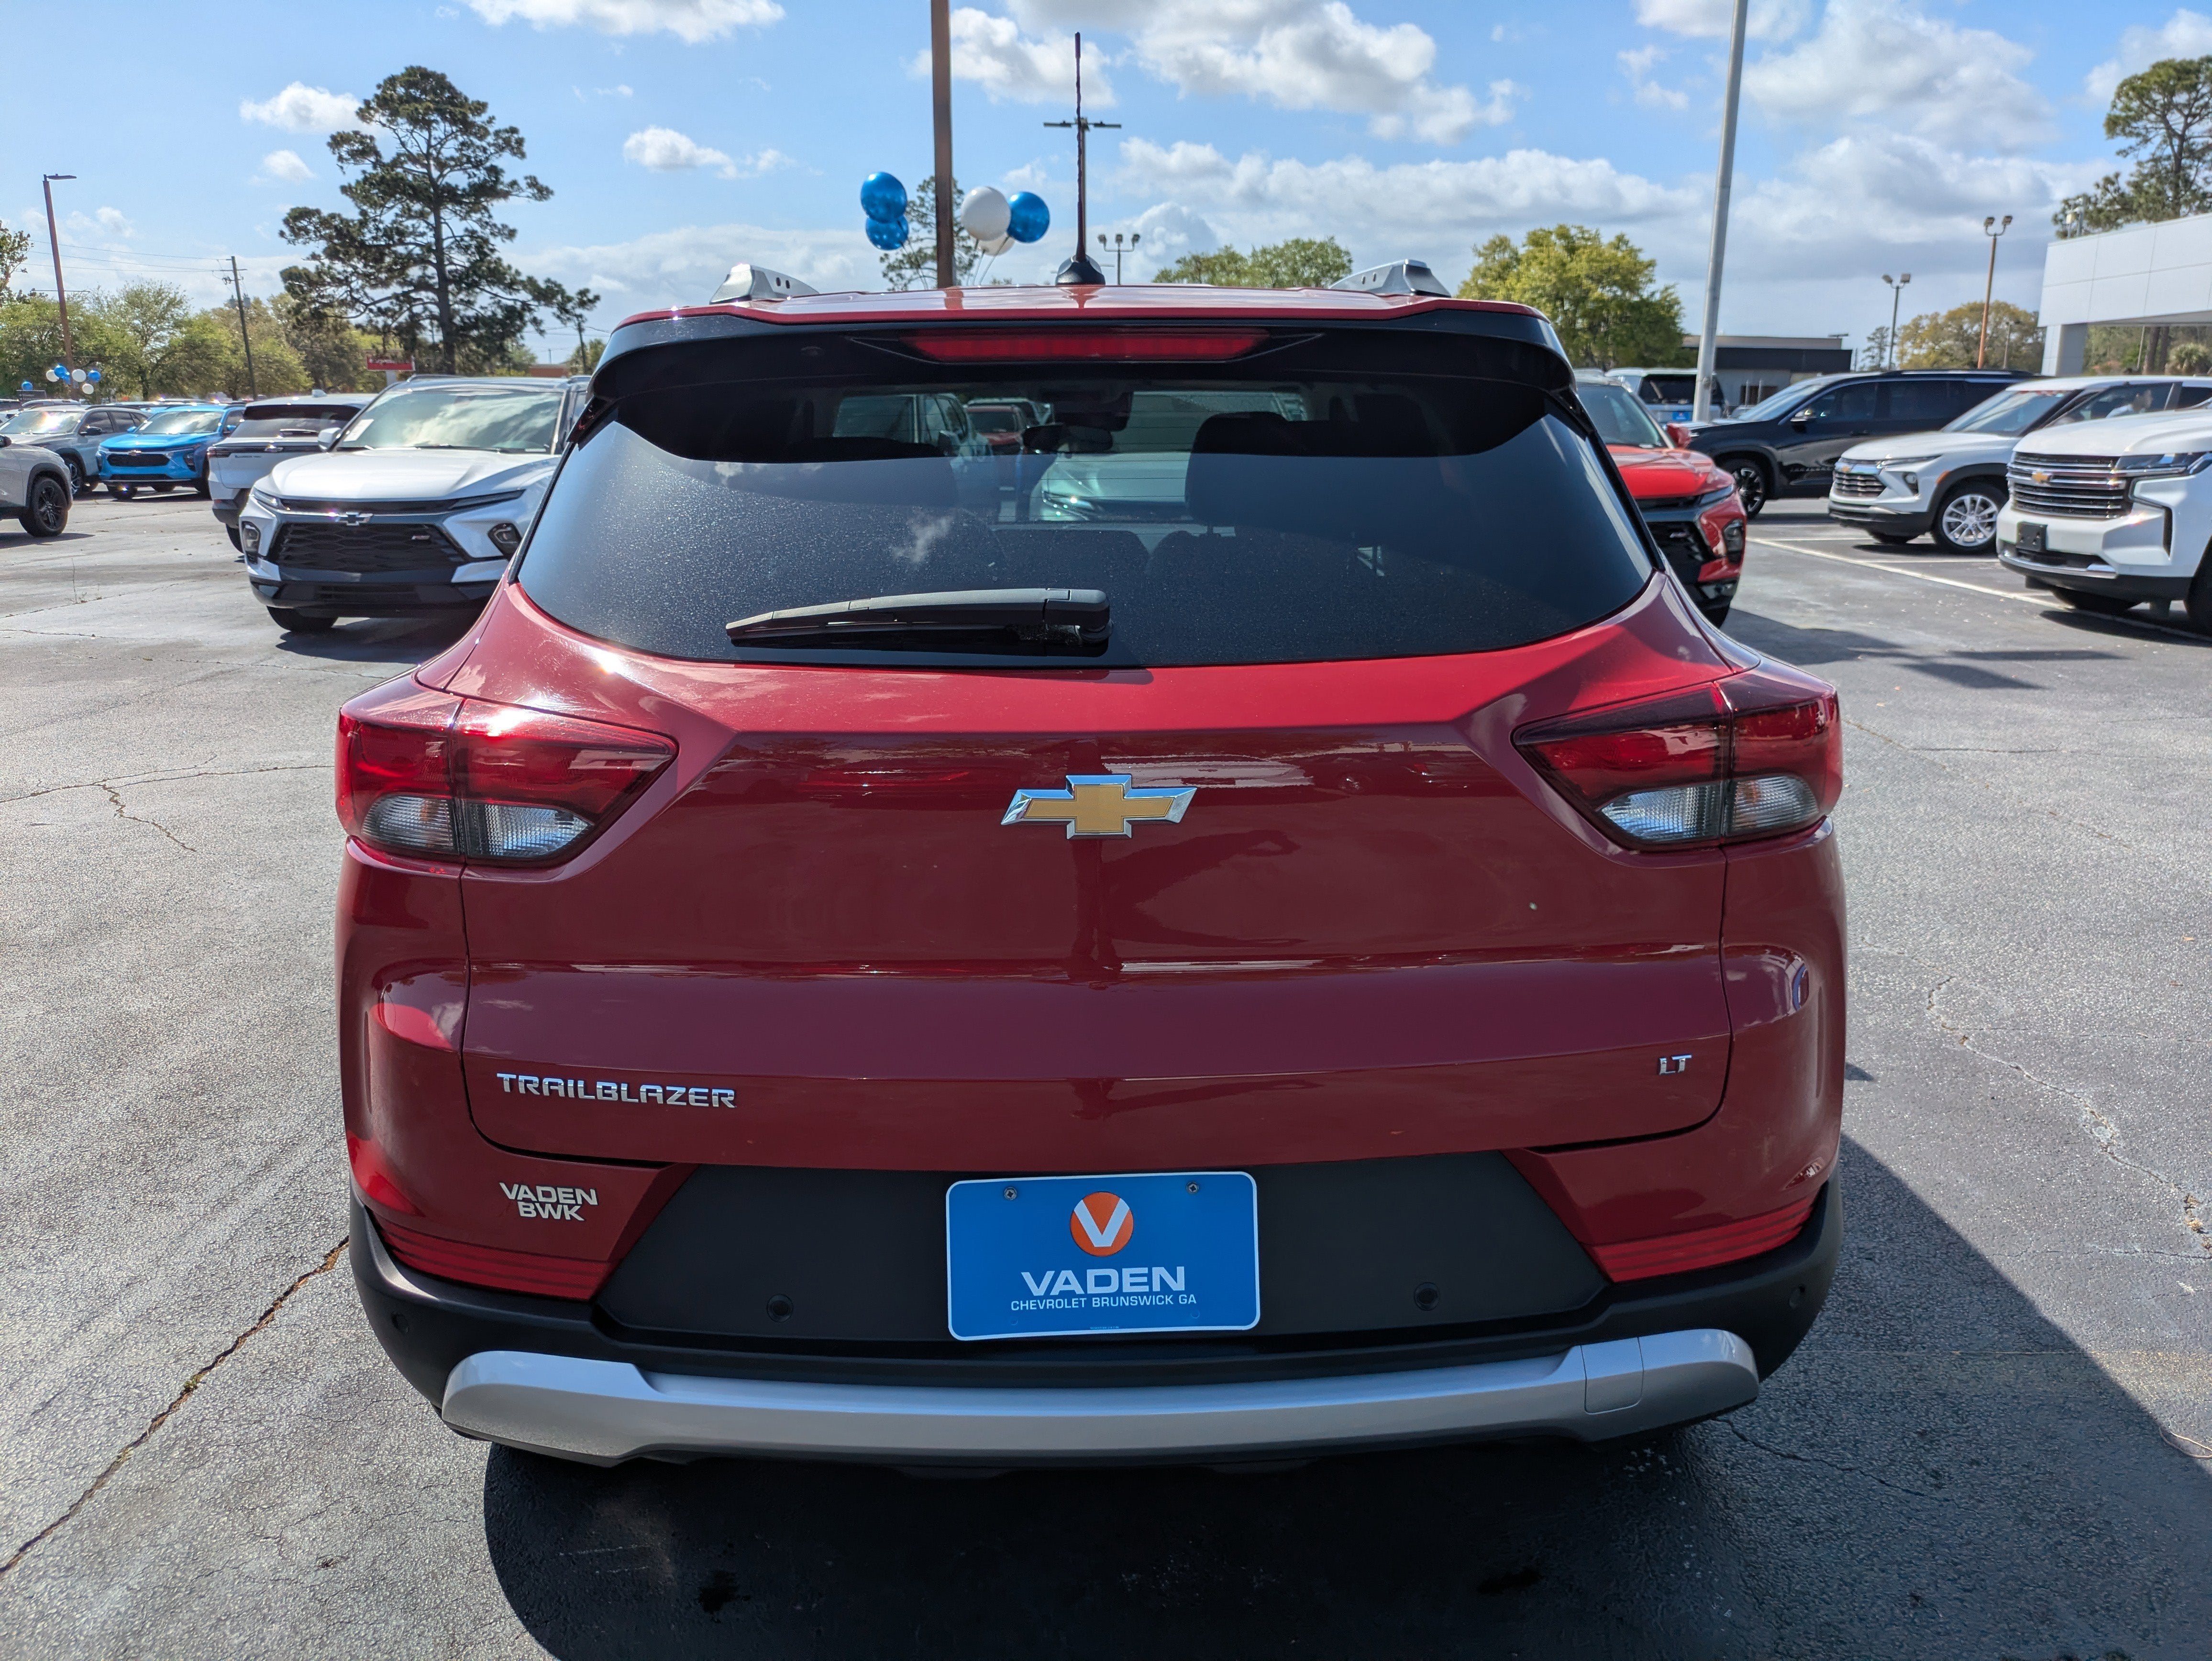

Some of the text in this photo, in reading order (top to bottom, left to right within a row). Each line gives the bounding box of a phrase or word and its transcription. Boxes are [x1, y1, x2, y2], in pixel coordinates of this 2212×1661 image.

[1659, 1054, 1692, 1075] LT
[497, 1073, 736, 1108] TRAILBLAZER
[499, 1182, 598, 1206] VADEN
[518, 1201, 585, 1221] BWK
[1021, 1266, 1185, 1296] VADEN
[1011, 1294, 1197, 1311] CHEVROLET BRUNSWICK GA
